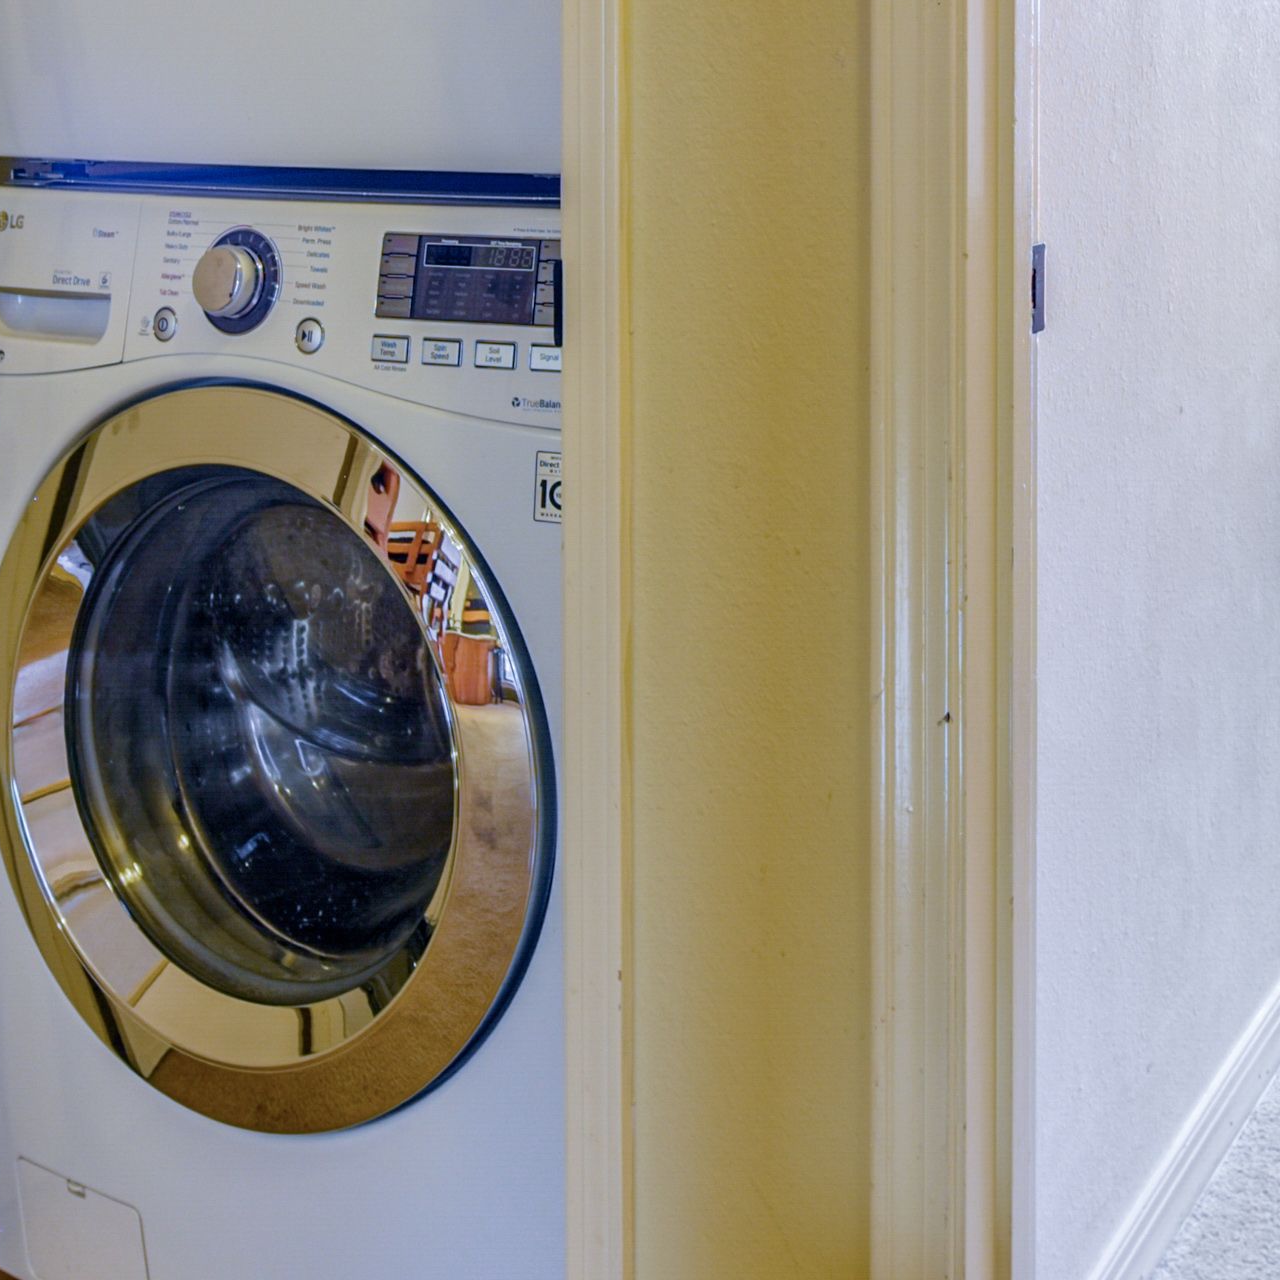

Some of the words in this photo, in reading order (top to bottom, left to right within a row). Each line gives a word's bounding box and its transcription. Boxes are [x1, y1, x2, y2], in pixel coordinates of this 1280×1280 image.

[10, 214, 25, 230] LG
[52, 273, 72, 285] Direct
[73, 275, 91, 287] Drive
[380, 340, 397, 348] Wash
[433, 343, 448, 352] Spin
[488, 346, 501, 355] Soil
[430, 351, 449, 361] Speed
[484, 354, 502, 363] Level
[539, 352, 560, 362] Signal
[539, 460, 560, 469] Direct
